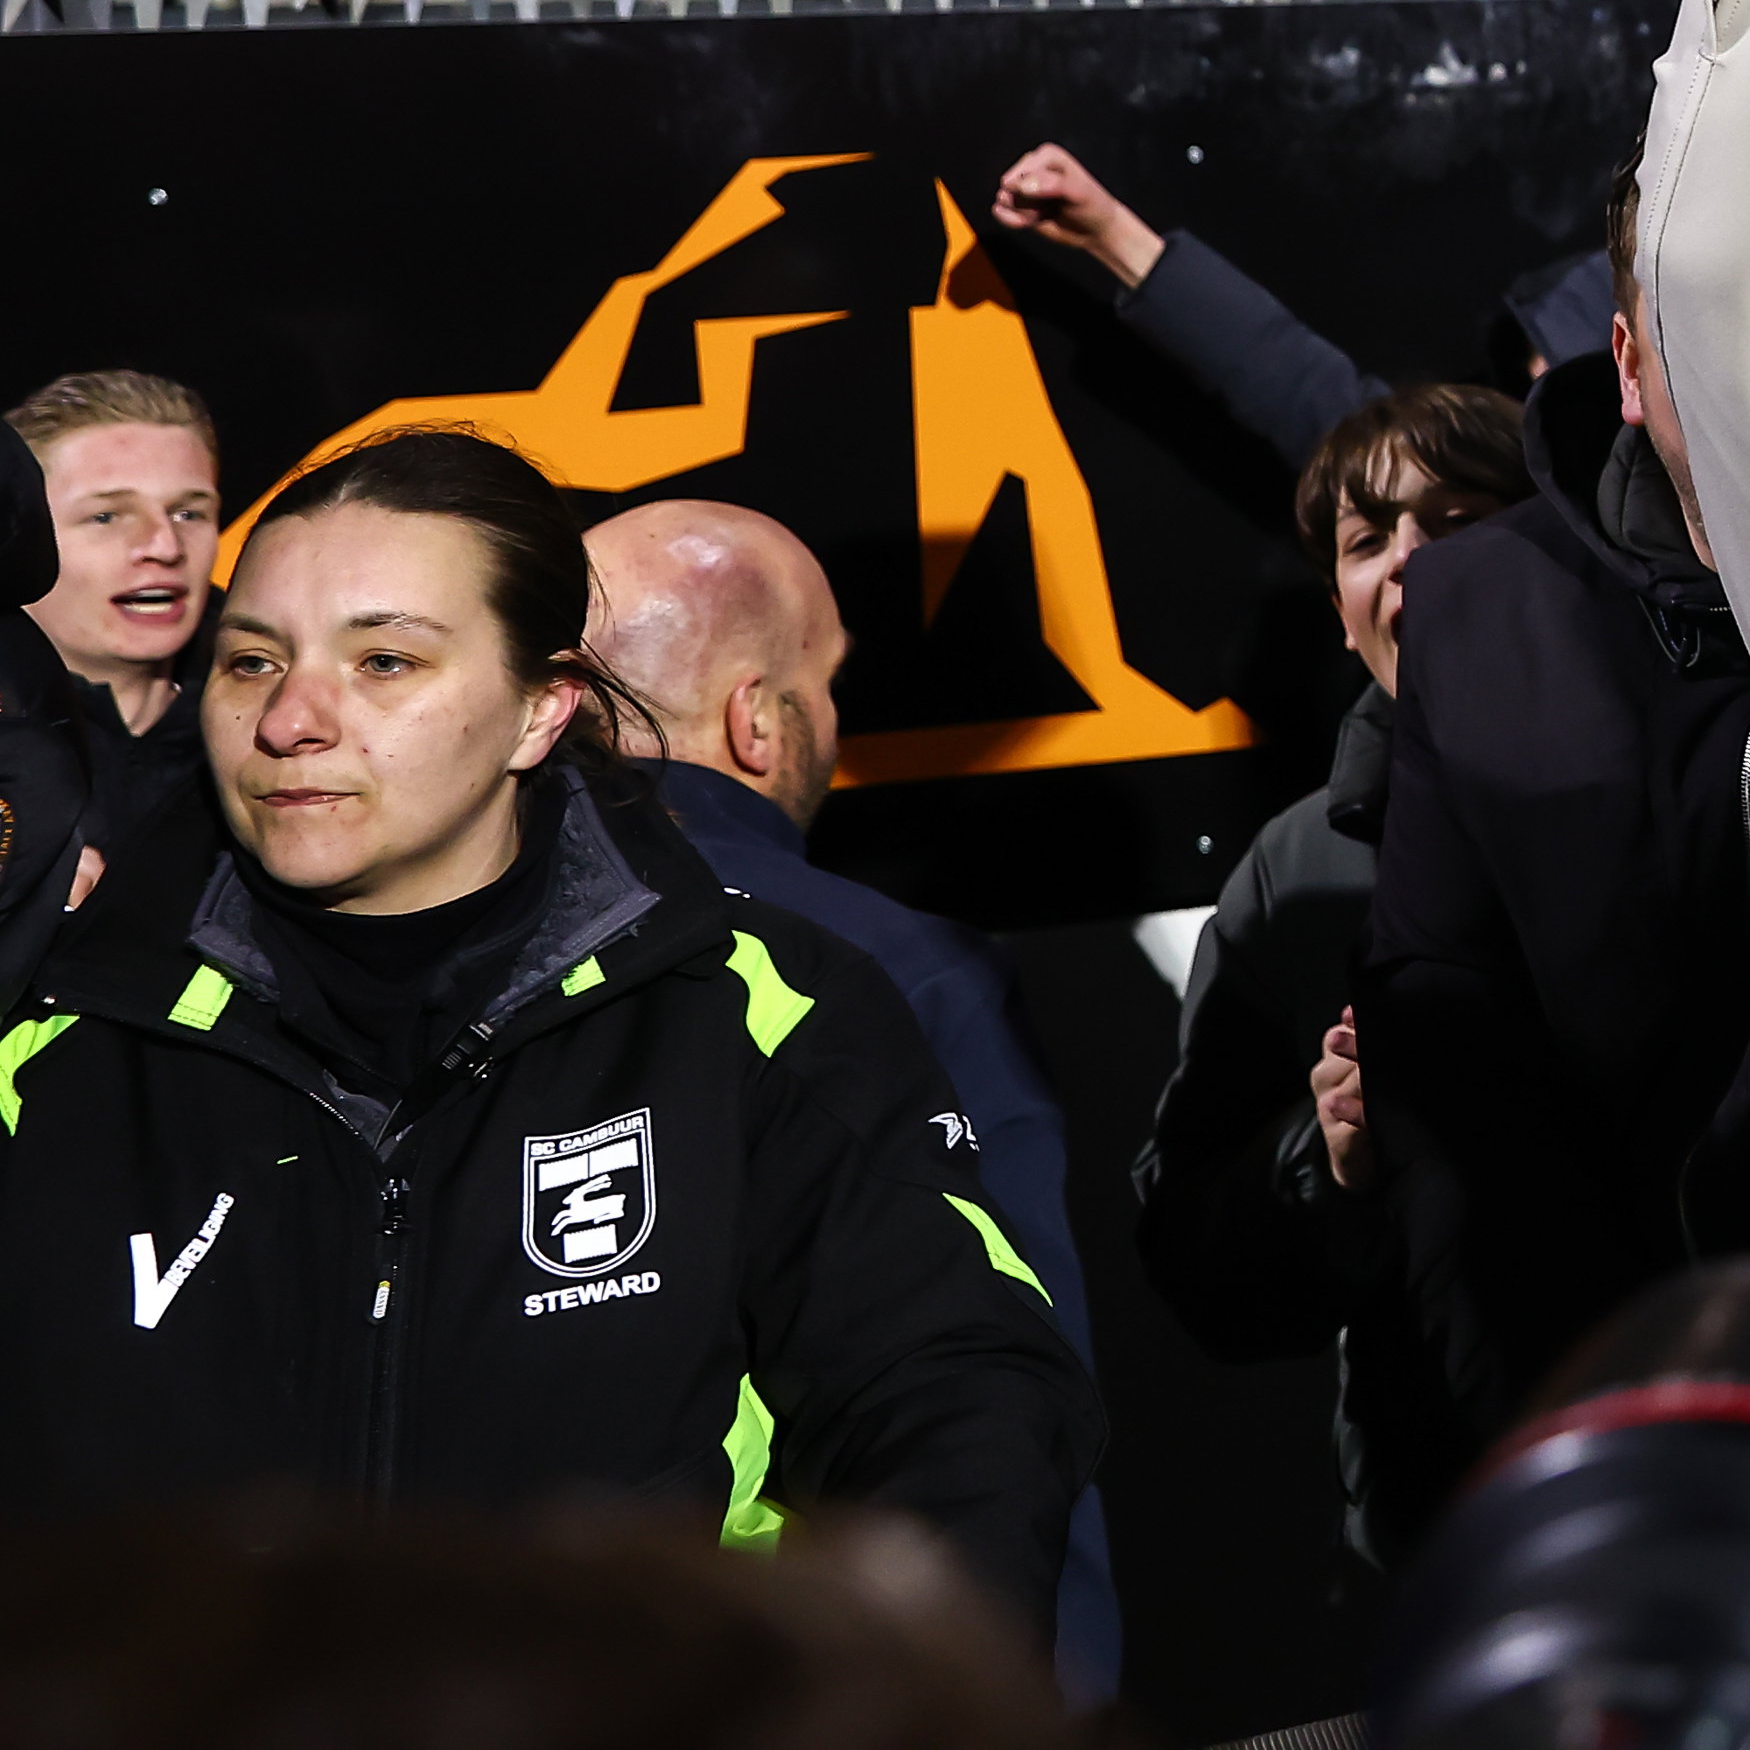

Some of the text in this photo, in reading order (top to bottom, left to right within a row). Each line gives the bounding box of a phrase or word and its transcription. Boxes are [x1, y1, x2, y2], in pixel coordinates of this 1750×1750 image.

[530, 1115, 645, 1157] SC CAMBUUR
[524, 1271, 661, 1317] STEWARD
